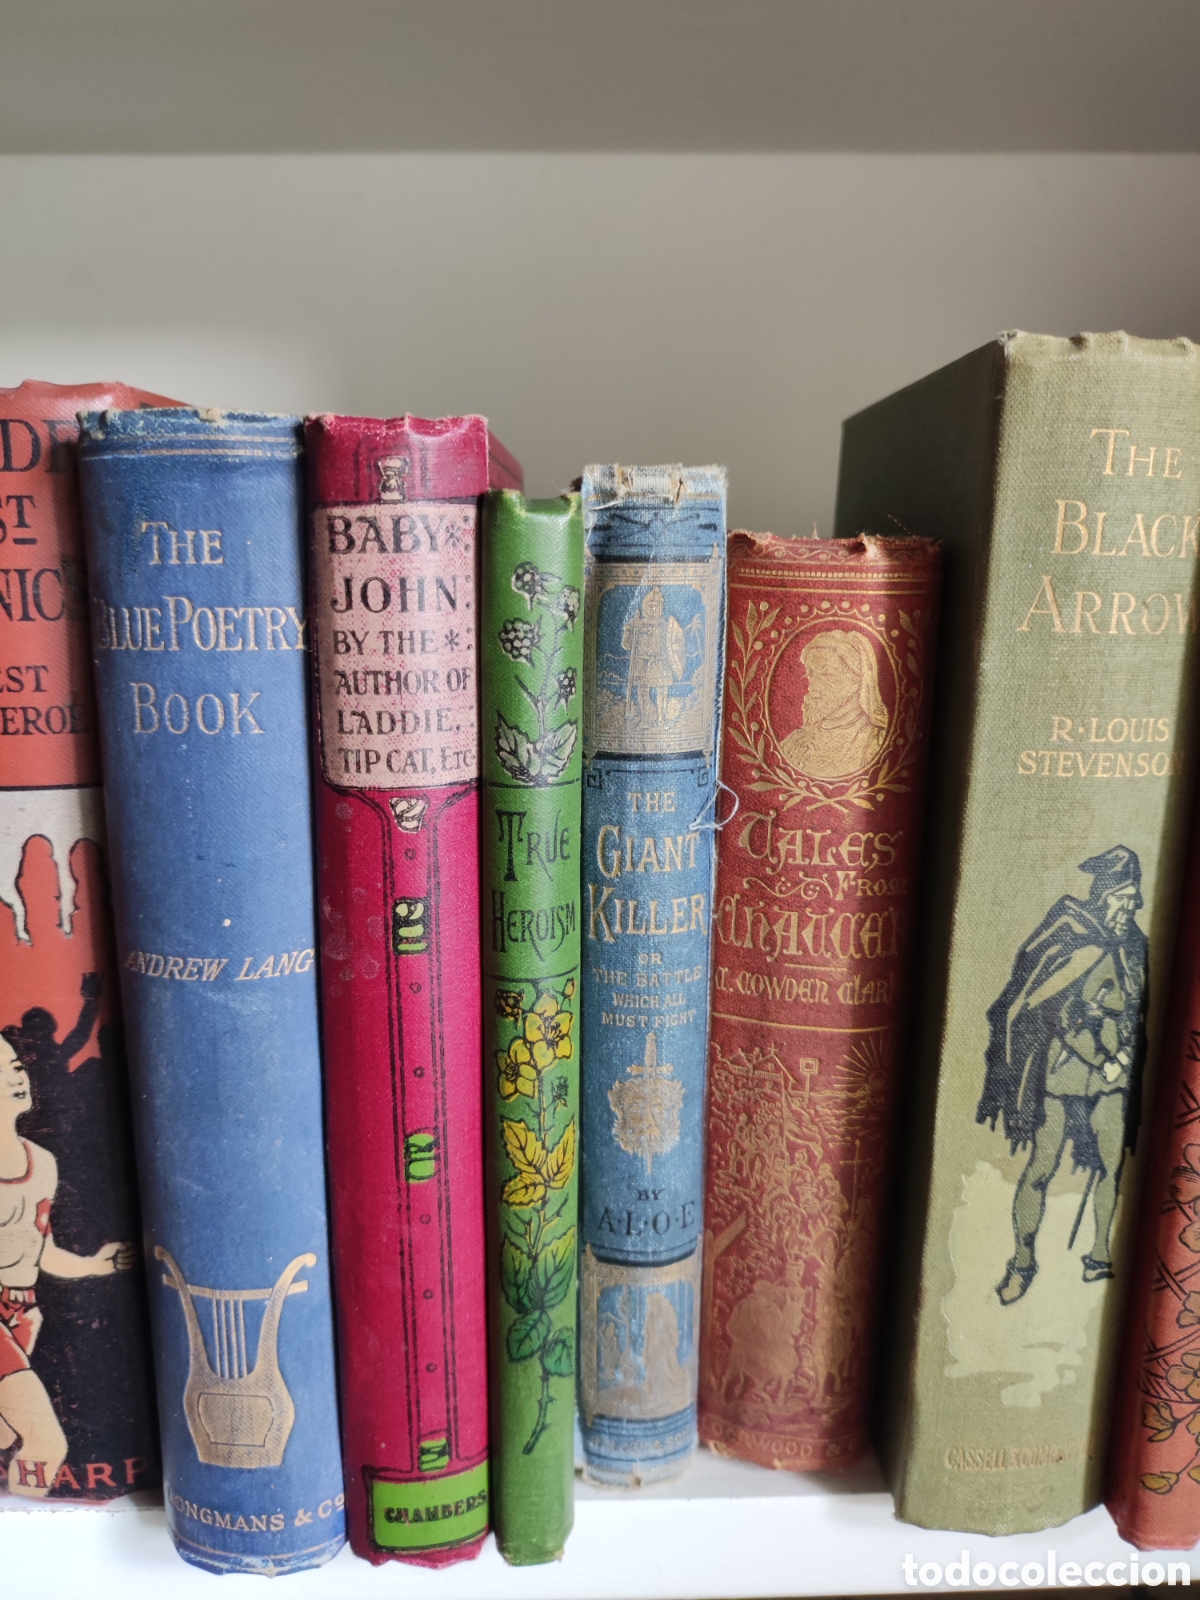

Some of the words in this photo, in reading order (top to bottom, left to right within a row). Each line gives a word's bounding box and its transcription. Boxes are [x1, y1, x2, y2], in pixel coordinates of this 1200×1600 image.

[1091, 429, 1183, 478] THE
[141, 521, 224, 565] THE
[327, 514, 447, 554] BABY
[1050, 499, 1200, 558] BLACK
[331, 576, 458, 613] JOHN
[1016, 575, 1199, 635] ARROW
[93, 598, 166, 651] BLUE
[162, 595, 309, 652] POETRY
[332, 629, 368, 656] BY
[380, 629, 437, 656] THE
[334, 666, 441, 696] AUTHOR
[446, 666, 472, 693] OF
[130, 682, 265, 734] BOOK
[338, 746, 382, 775] TIP
[1017, 750, 1183, 778] STEVENSON
[627, 791, 677, 813] THE
[494, 810, 571, 882] TRUE
[597, 824, 700, 880] GIANT
[739, 809, 903, 876] TALES
[835, 870, 906, 901] FROM
[491, 889, 577, 963] HEROISM
[588, 883, 707, 944] KILLER
[124, 950, 230, 982] ANDREW
[234, 947, 315, 981] LANG
[592, 967, 629, 987] THE
[636, 965, 702, 988] BATTLE
[638, 952, 664, 965] OR
[601, 1011, 649, 1028] MUST
[654, 1008, 697, 1028] FIGHT
[612, 991, 660, 1009] WHICH
[663, 992, 687, 1008] ALL
[636, 1189, 665, 1201] BY
[168, 1489, 286, 1532] LONGMANS
[294, 1508, 313, 1527] &
[383, 1488, 488, 1524] CHAMBERS
